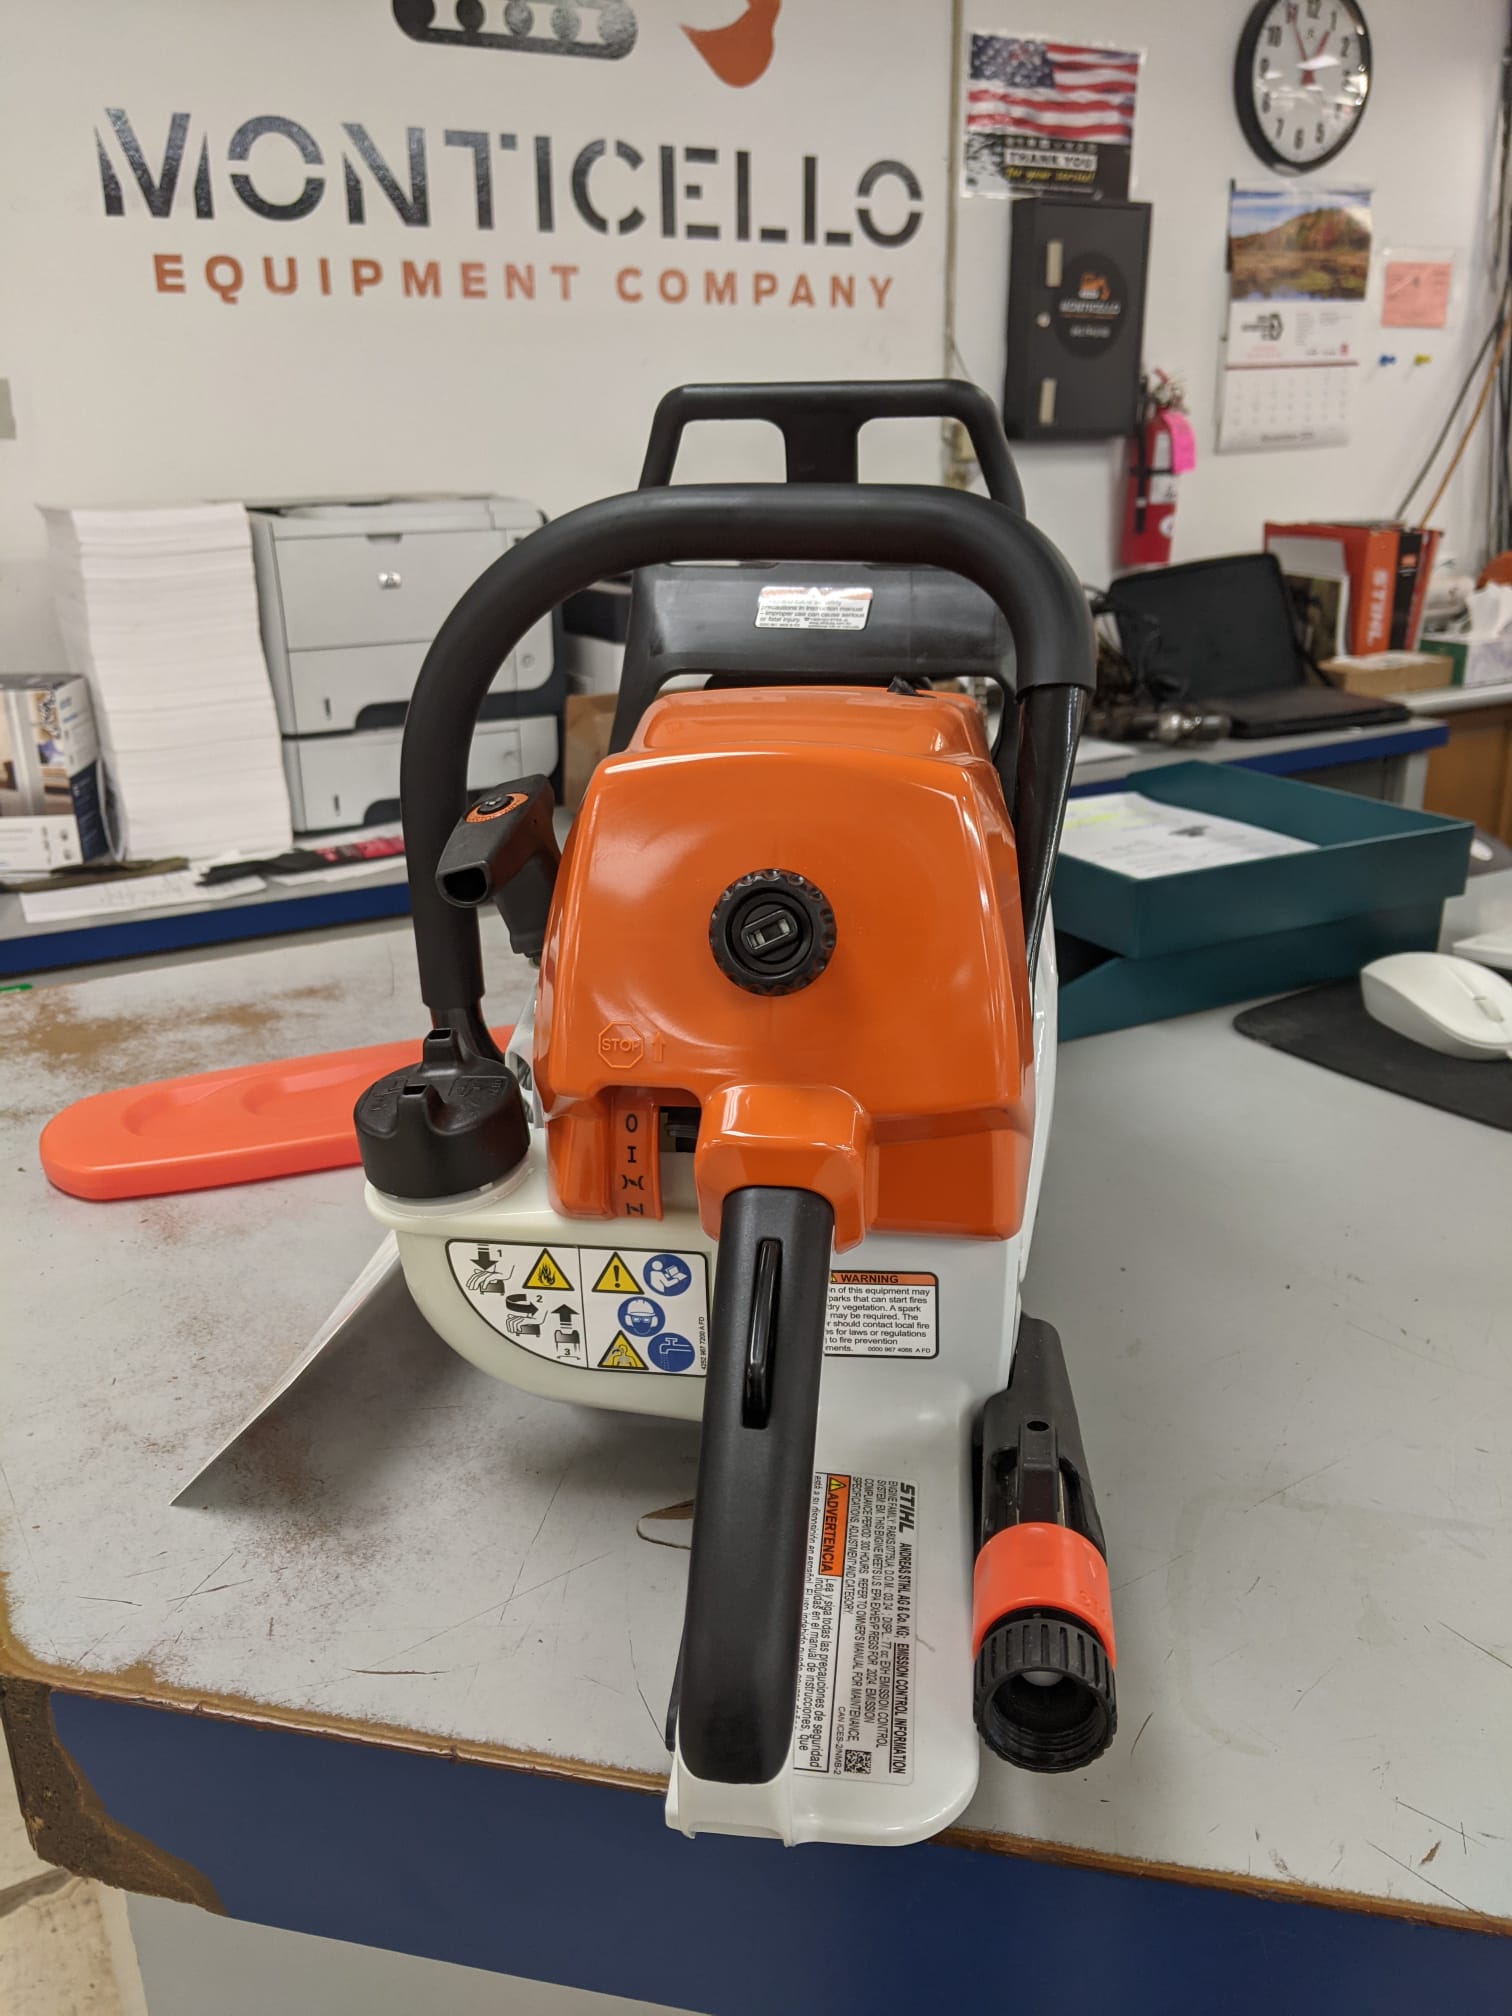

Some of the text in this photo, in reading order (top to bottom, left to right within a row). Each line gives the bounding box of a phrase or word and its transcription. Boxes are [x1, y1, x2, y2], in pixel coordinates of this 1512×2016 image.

[1064, 154, 1093, 168] YOU
[94, 107, 924, 248] MONTICELLO
[154, 253, 896, 310] EQUIPMENT COMPANY
[601, 1038, 643, 1051] STOP
[841, 1274, 899, 1284] WARNING
[536, 1295, 543, 1303] 2
[828, 1294, 851, 1302] parks
[853, 1295, 868, 1303] that
[889, 1296, 907, 1304] start
[909, 1296, 928, 1304] fires
[838, 1286, 846, 1294] of
[848, 1286, 863, 1294] this
[865, 1287, 909, 1298] equipment
[911, 1289, 930, 1297] may
[842, 1304, 887, 1312] vegetation.
[898, 1305, 921, 1313] spark
[833, 1320, 860, 1328] should
[863, 1321, 893, 1329] contact
[895, 1321, 914, 1329] local
[863, 1313, 900, 1322] required.
[836, 1328, 846, 1336] for
[881, 1329, 926, 1338] regulations
[839, 1336, 853, 1344] fire
[854, 1337, 898, 1346] prevention
[564, 1348, 571, 1356] 3
[863, 1478, 875, 1516] COMPLIANCE
[888, 1480, 898, 1502] ENGINE
[899, 1482, 916, 1534] STIHL
[875, 1516, 885, 1530] THIS
[821, 1492, 840, 1572] ADVERTENCIA
[861, 1540, 871, 1551] 300
[874, 1530, 884, 1553] ENGINE
[873, 1554, 883, 1574] MEETS
[899, 1542, 912, 1574] ANDREAS
[846, 1565, 856, 1578] AND
[825, 1578, 837, 1592] Lea
[858, 1578, 869, 1600] REFER
[898, 1574, 911, 1592] STIHL
[813, 1578, 825, 1610] incluidas
[871, 1588, 881, 1601] EPA
[898, 1594, 911, 1606] AG
[819, 1600, 834, 1616] siga
[857, 1600, 867, 1610] TO
[812, 1612, 820, 1621] en
[898, 1612, 910, 1624] Co.
[811, 1622, 821, 1630] el
[821, 1618, 833, 1639] todas
[808, 1631, 820, 1660] manual
[820, 1640, 832, 1652] las
[868, 1630, 879, 1650] REGS
[881, 1642, 891, 1650] 77
[853, 1642, 865, 1670] MANUAL
[867, 1650, 878, 1666] FOR
[896, 1643, 909, 1678] EMISSION
[807, 1662, 817, 1673] de
[880, 1660, 890, 1675] EXH
[813, 1654, 830, 1709] precauciones
[852, 1672, 863, 1687] FOR
[878, 1676, 889, 1710] EMISSION
[895, 1680, 908, 1716] CONTROL
[864, 1688, 875, 1724] EMISSION
[814, 1710, 826, 1722] de
[838, 1706, 846, 1722] CAN
[877, 1712, 888, 1748] CONTROL
[797, 1734, 809, 1751] que
[808, 1723, 826, 1768] seguridad
[894, 1718, 907, 1774] INFORMATION
